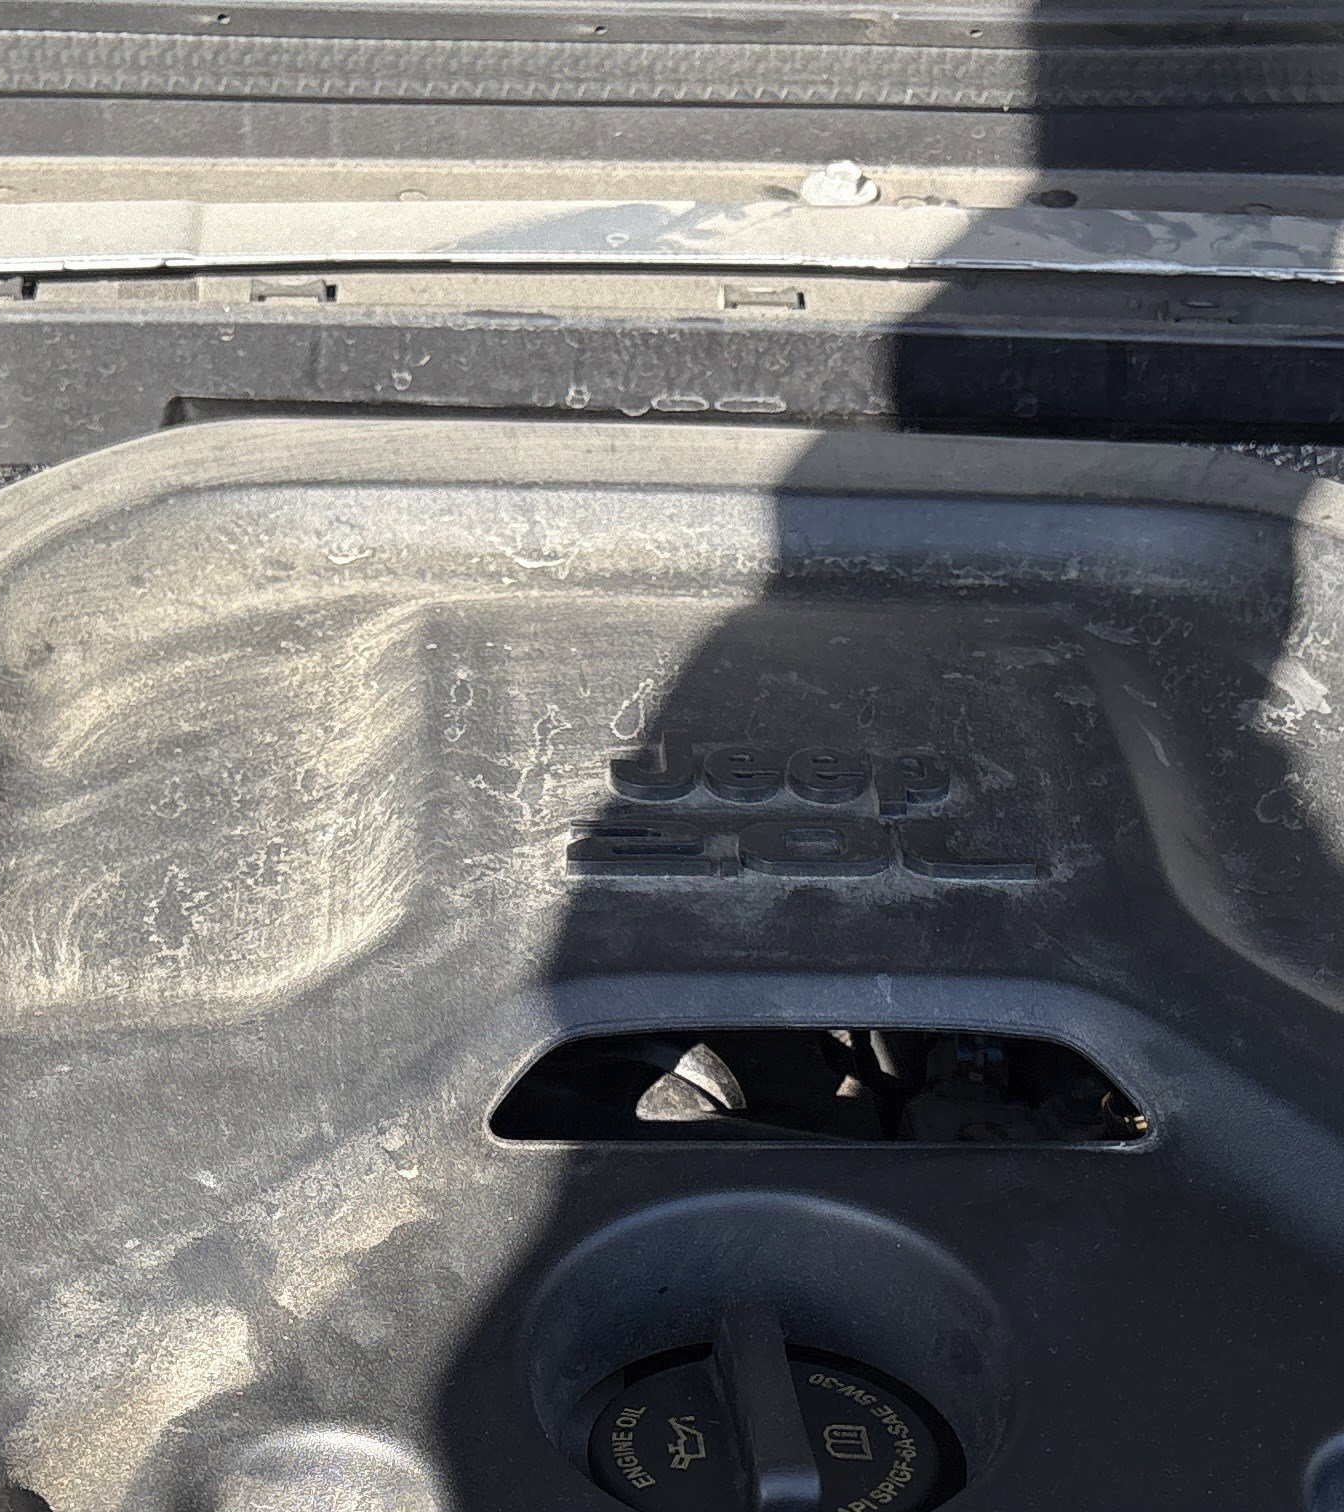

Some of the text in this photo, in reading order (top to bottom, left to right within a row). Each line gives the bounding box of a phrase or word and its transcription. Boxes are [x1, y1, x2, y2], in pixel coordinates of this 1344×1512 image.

[609, 731, 953, 816] Jeep
[566, 819, 1048, 882] 2.0L
[808, 1373, 878, 1406] 5W-30
[611, 1406, 656, 1489] ENGINE OIL
